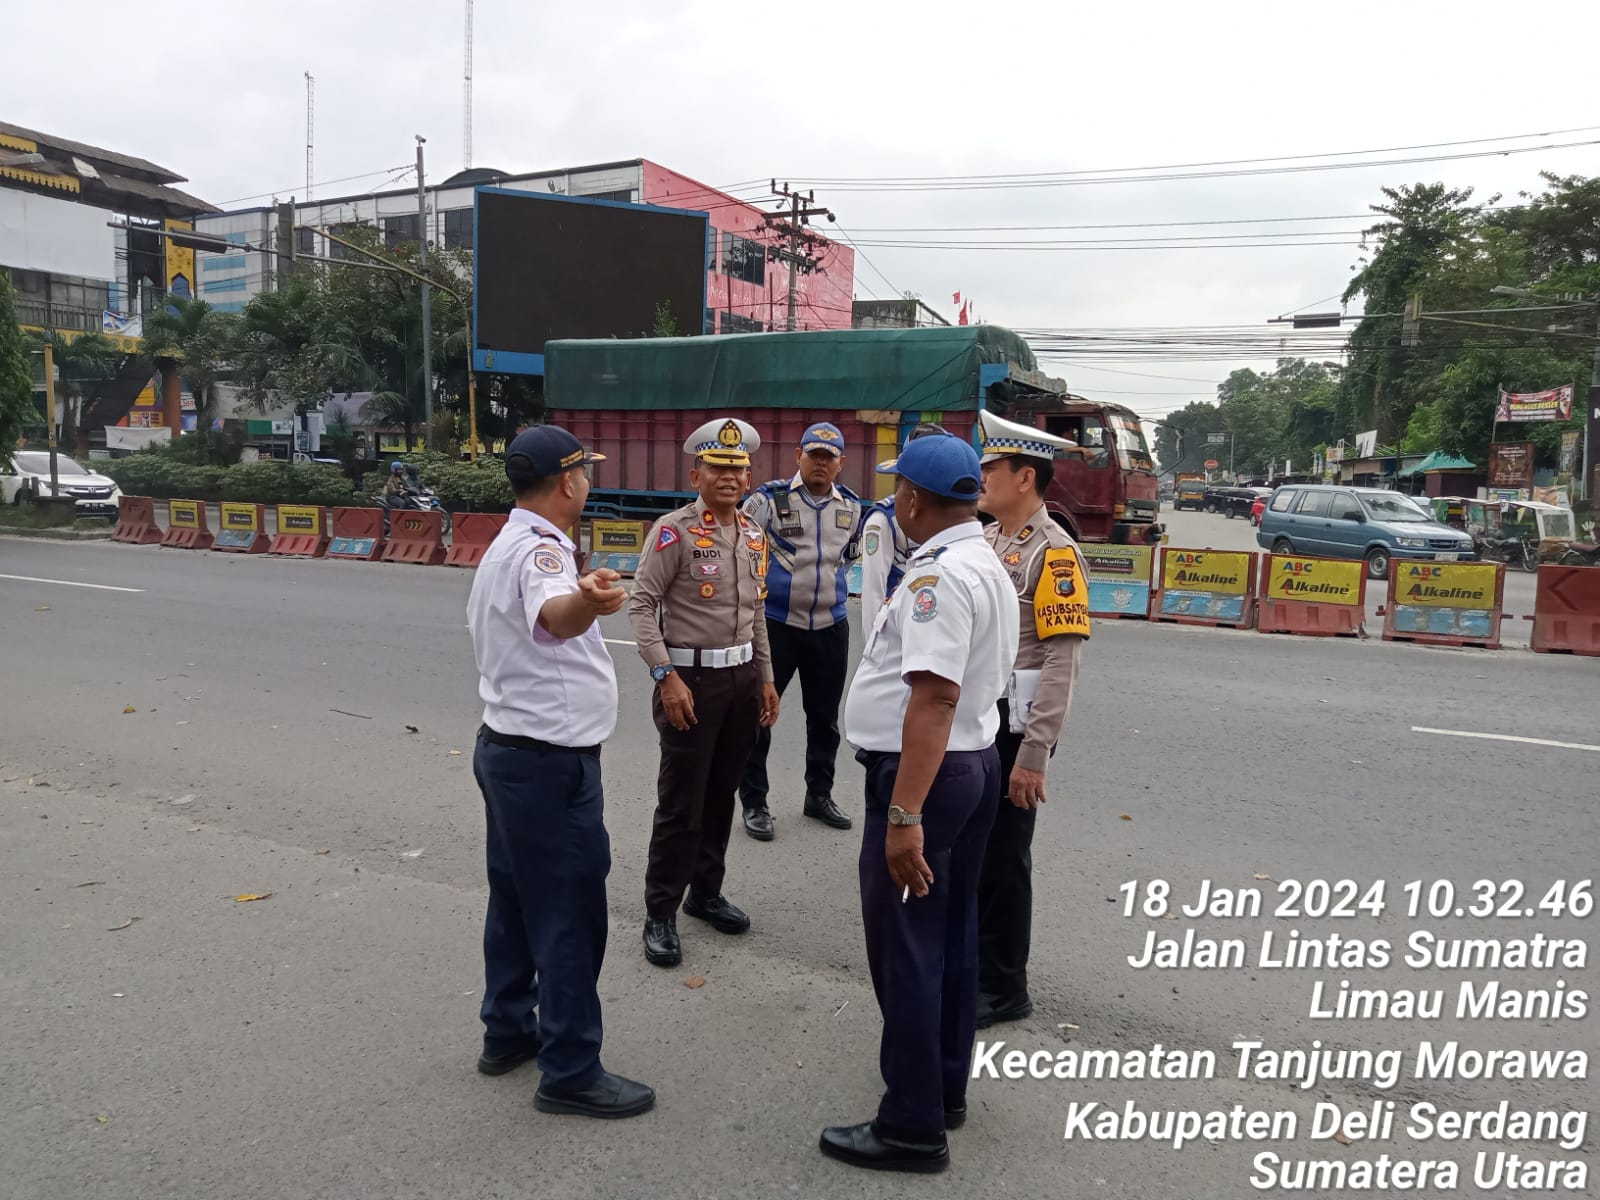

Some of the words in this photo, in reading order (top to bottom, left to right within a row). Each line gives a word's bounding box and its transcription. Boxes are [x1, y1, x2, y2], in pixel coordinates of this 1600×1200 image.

[693, 549, 721, 559] BUDI
[1175, 554, 1203, 564] ABC
[1283, 561, 1313, 573] ABC
[1409, 566, 1442, 577] ABC
[1174, 569, 1238, 585] Alkaline
[1280, 578, 1350, 595] Alkaline
[1406, 583, 1484, 599] Alkaline
[1045, 614, 1087, 628] KAWAL
